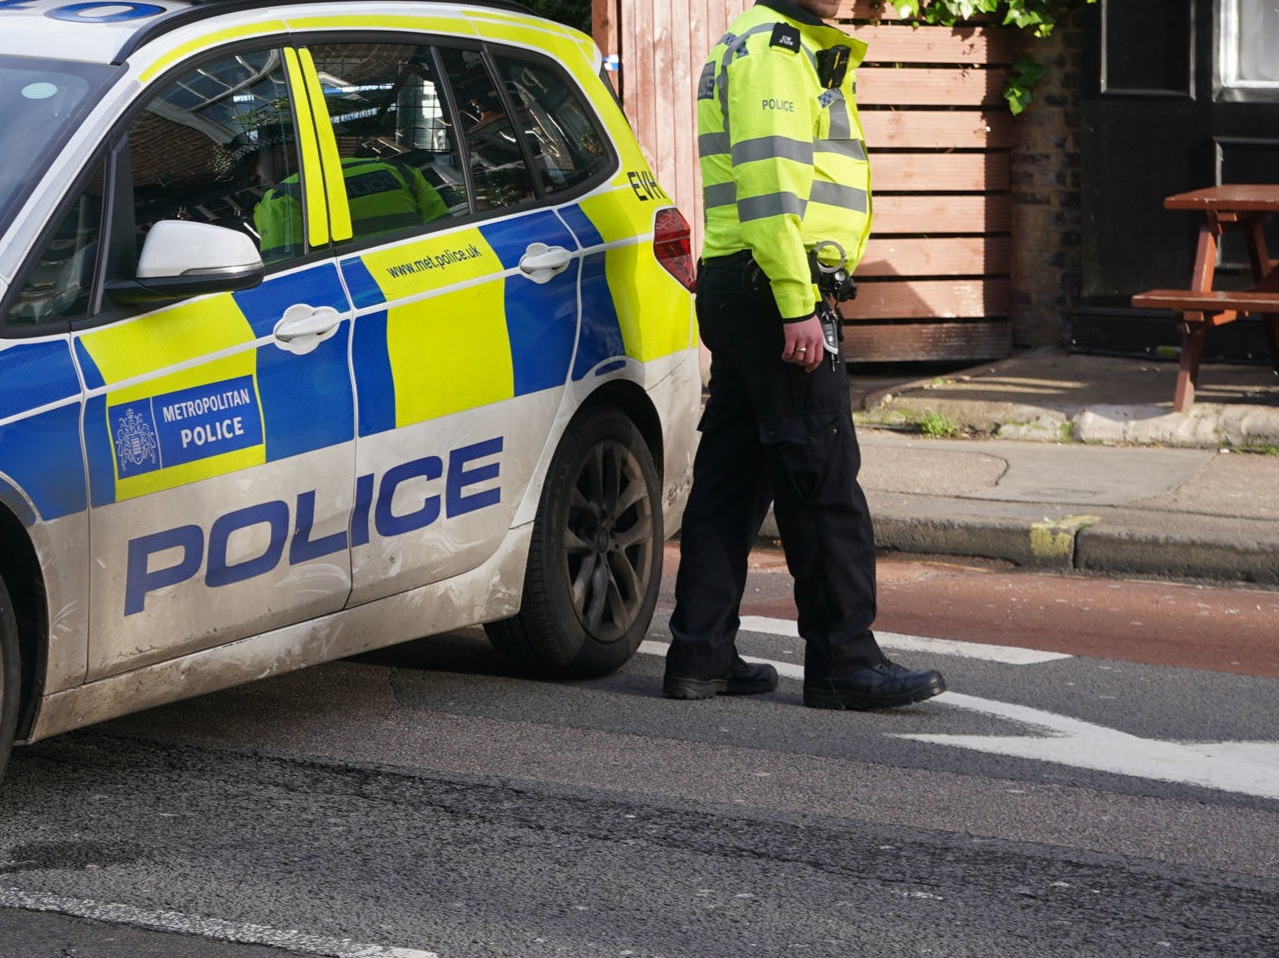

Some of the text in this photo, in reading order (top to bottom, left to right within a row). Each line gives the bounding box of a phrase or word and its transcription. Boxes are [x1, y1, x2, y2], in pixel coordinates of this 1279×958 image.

[762, 98, 794, 113] POLICE
[386, 244, 483, 278] www.met.police.uk
[162, 388, 251, 423] METROPOLITAN
[180, 416, 245, 449] POLICE
[124, 436, 504, 617] POLICE
